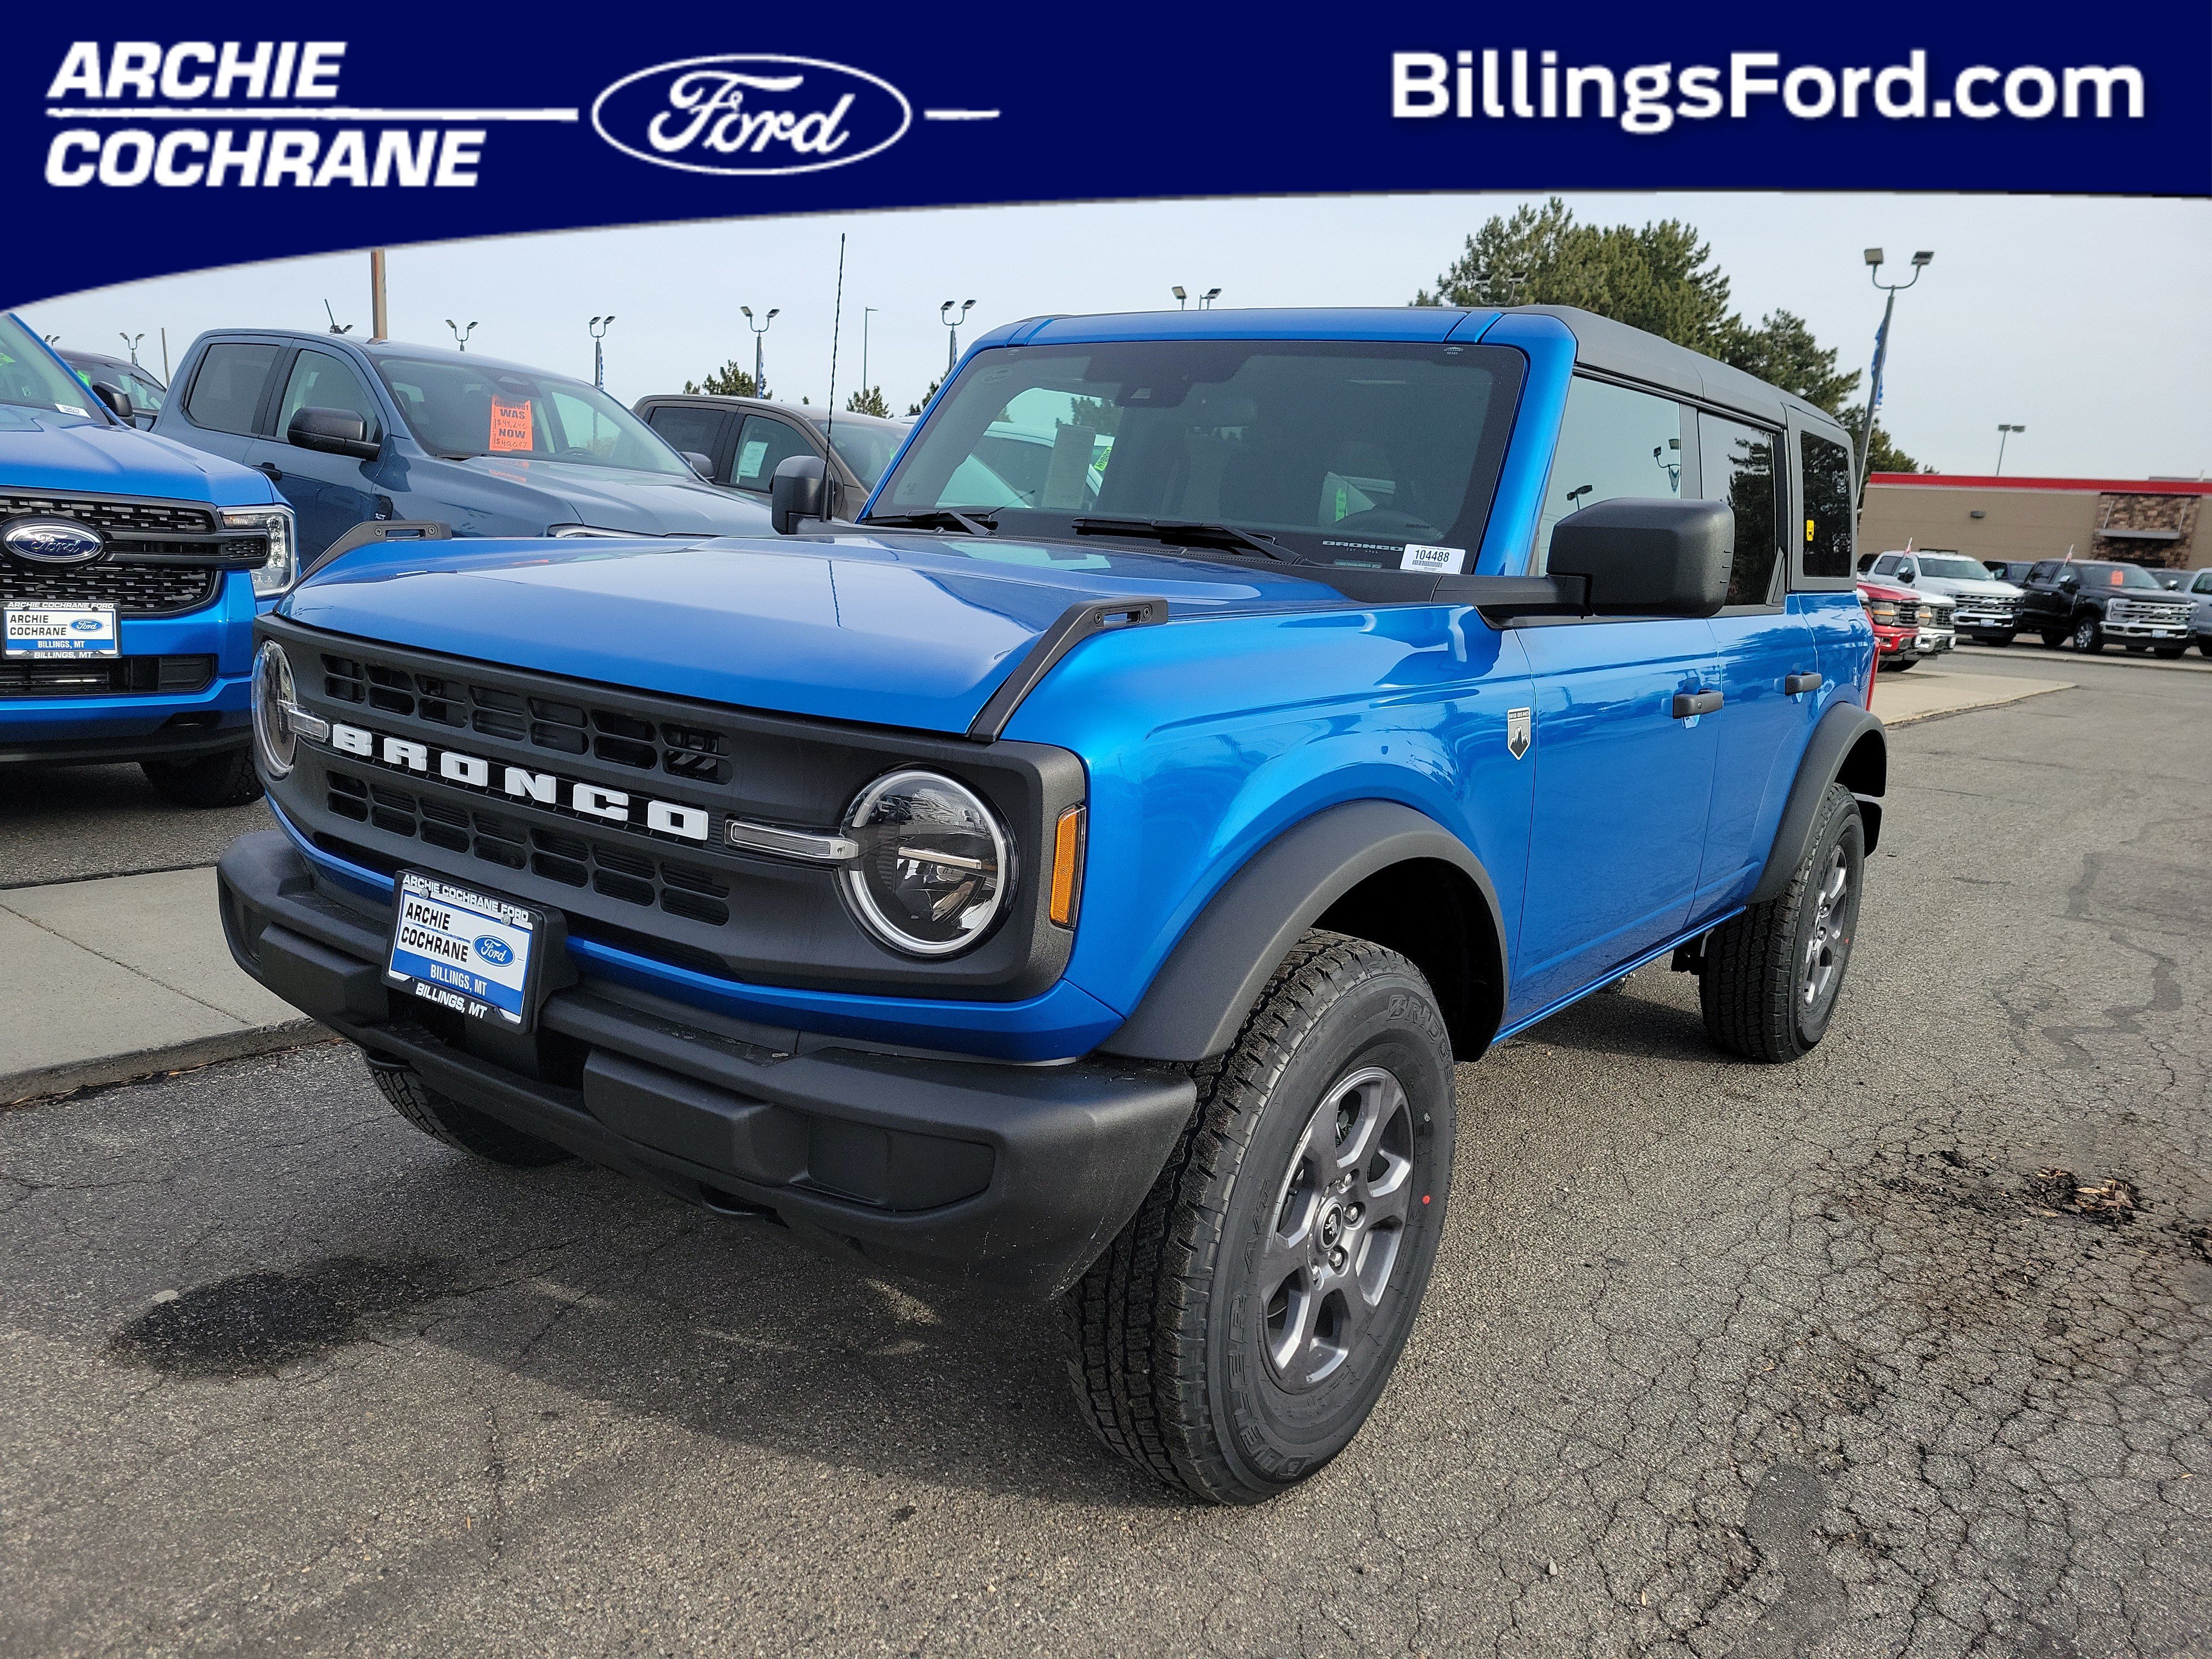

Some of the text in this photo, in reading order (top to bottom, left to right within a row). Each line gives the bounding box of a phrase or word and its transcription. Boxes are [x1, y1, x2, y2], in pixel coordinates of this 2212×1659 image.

[500, 409, 525, 419] WAS
[498, 428, 526, 438] NOW
[29, 532, 81, 552] Ford
[1322, 540, 1403, 551] BRONCO
[1415, 549, 1450, 562] 104488
[10, 614, 49, 623] ARCHIE
[77, 620, 97, 630] Ford
[10, 627, 67, 636] COCHRANE
[332, 723, 709, 841] BRONCO
[403, 874, 529, 922] ARCHIE COCHRANE FORD
[405, 902, 451, 931] ARCHIE
[401, 927, 469, 963] COCHRANE
[481, 939, 506, 962] Ford
[430, 964, 487, 996] BILLINGS, MT
[415, 982, 488, 1019] BILLINGS, MT
[1228, 1293, 1312, 1477] DUELER
